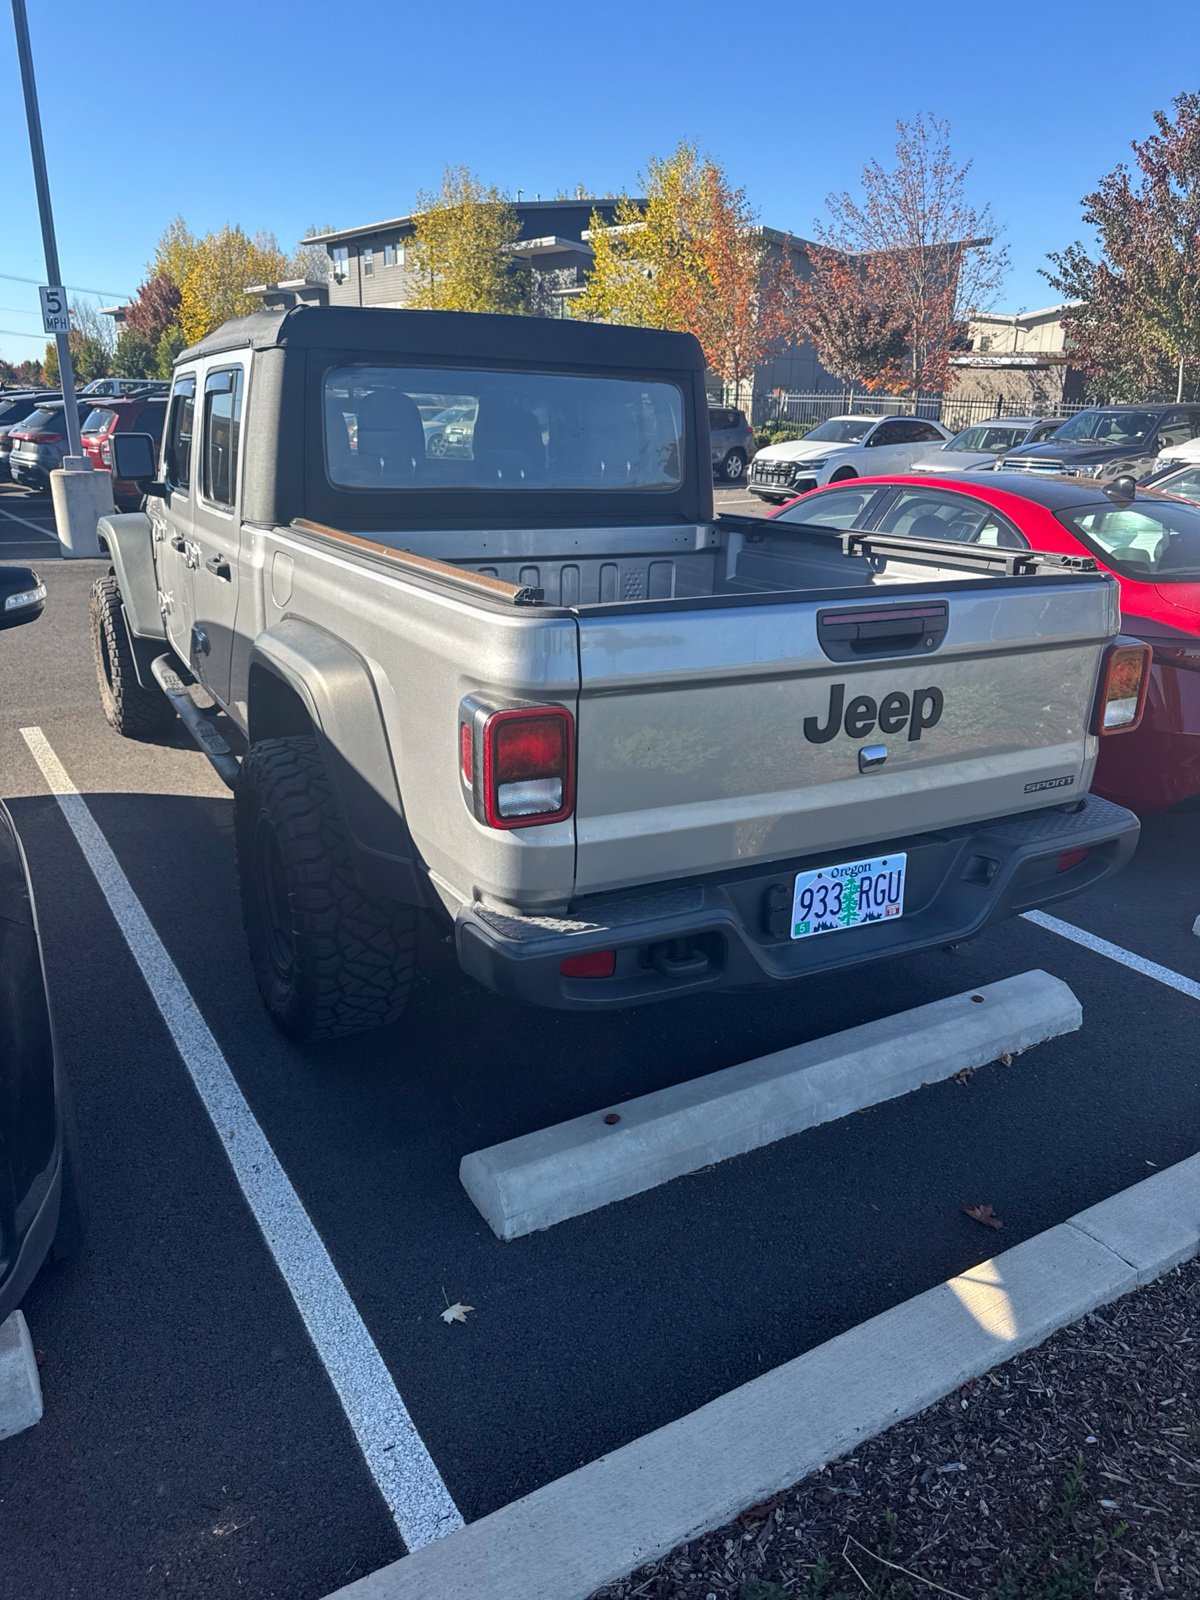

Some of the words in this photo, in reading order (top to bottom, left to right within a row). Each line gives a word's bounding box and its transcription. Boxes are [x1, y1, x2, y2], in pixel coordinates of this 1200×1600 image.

[46, 292, 62, 314] 5
[46, 317, 67, 329] MPH
[803, 683, 944, 744] Jeep
[1024, 776, 1074, 793] SPORT
[831, 863, 872, 879] Oregon
[800, 882, 844, 922] 933
[858, 870, 902, 911] RGU
